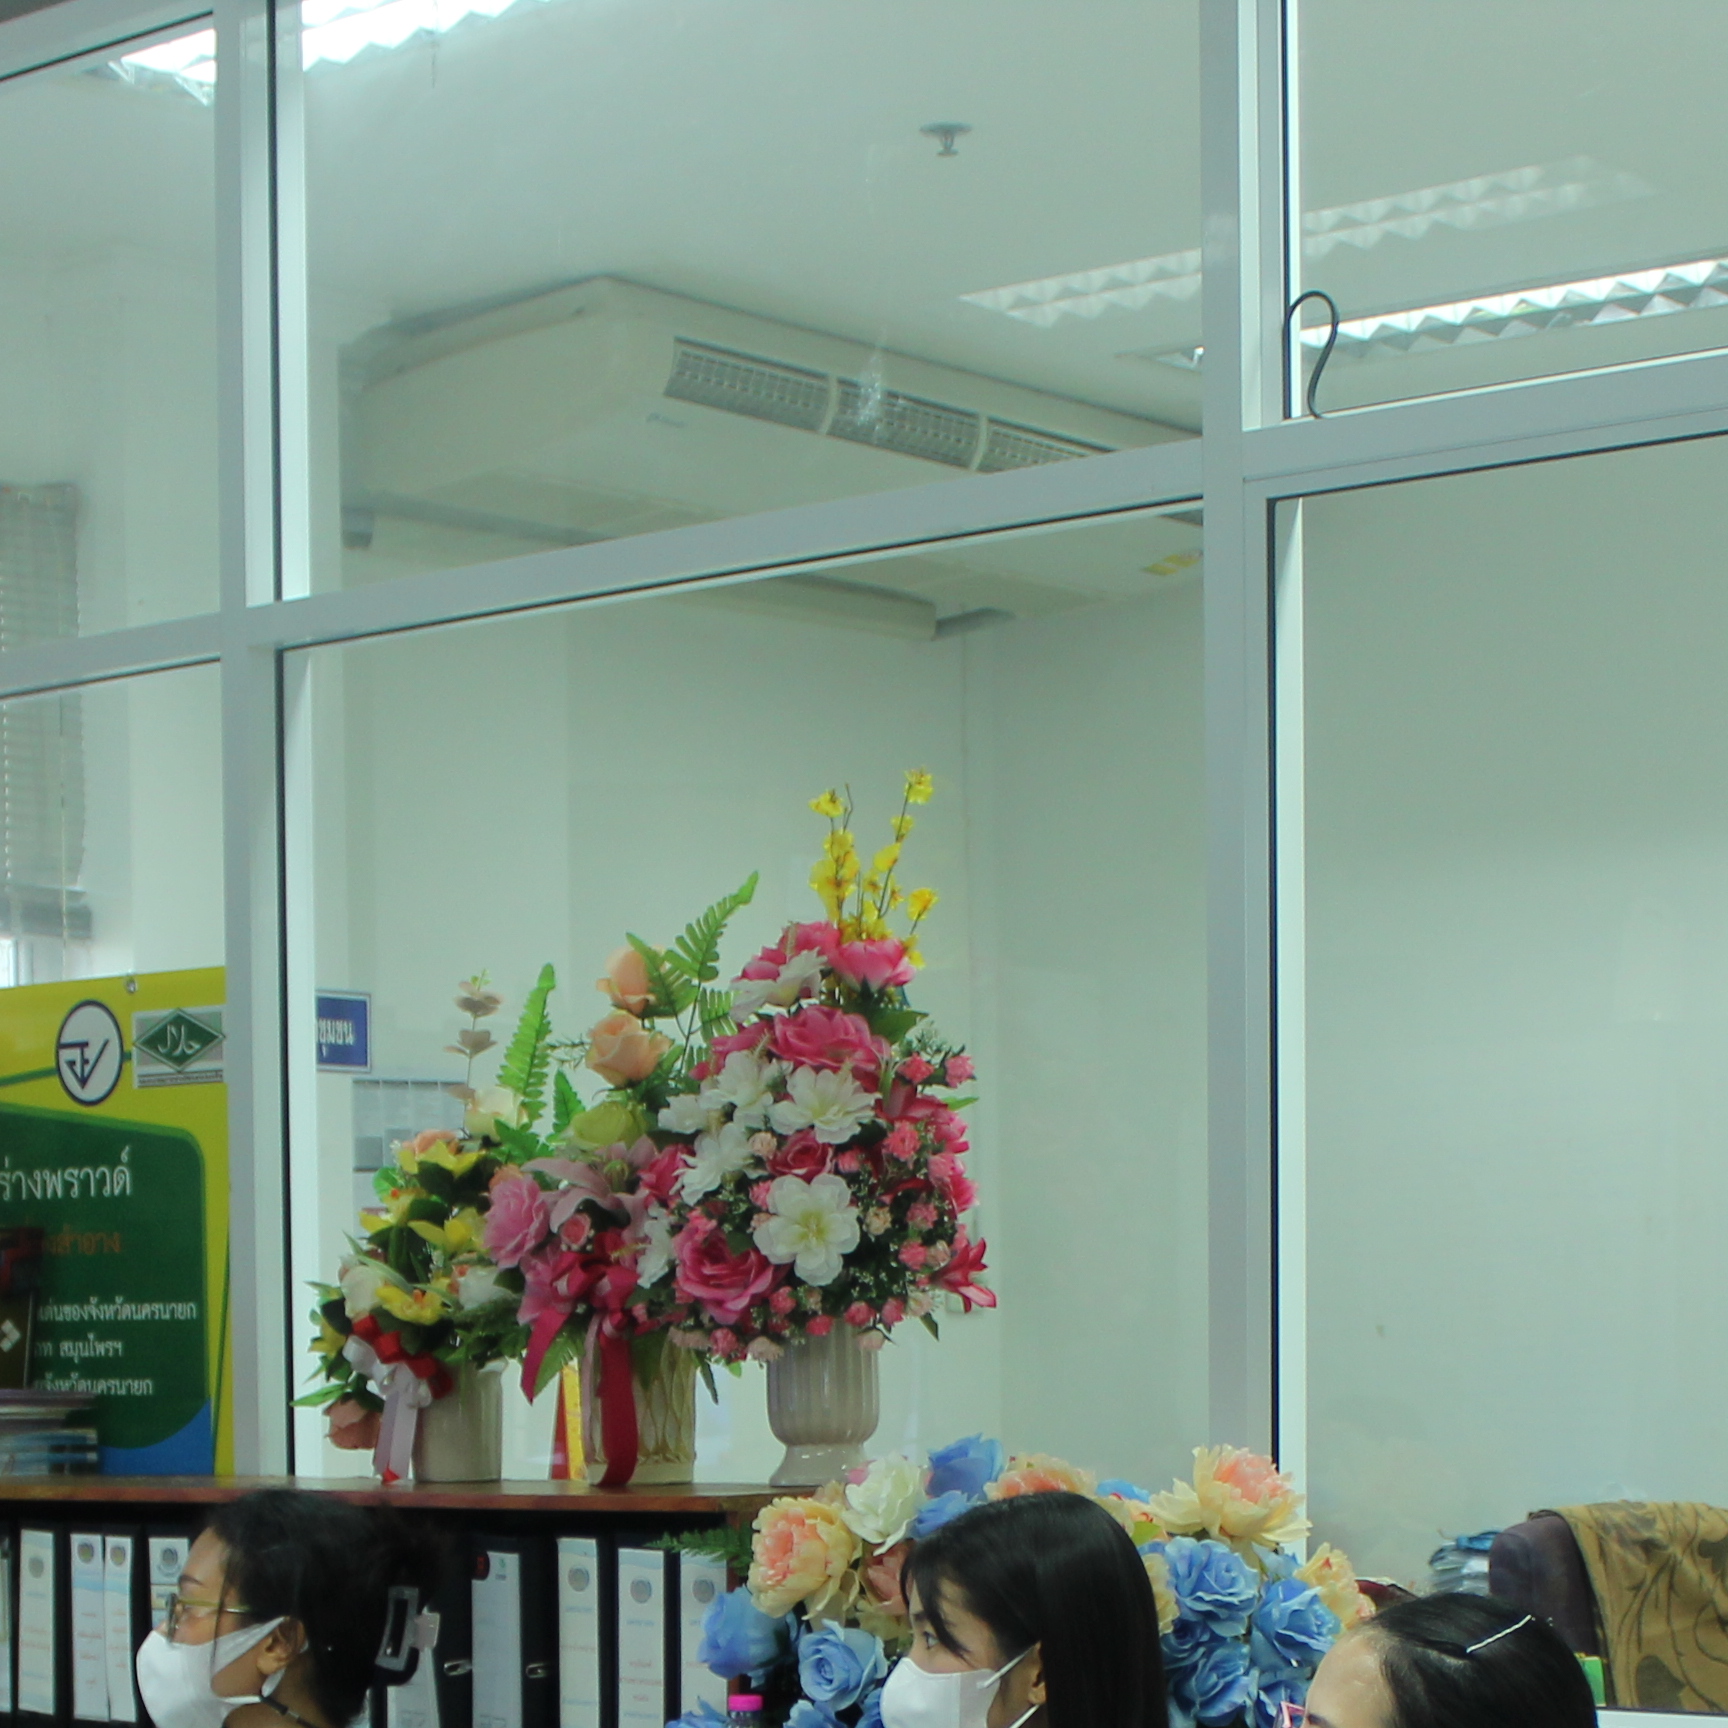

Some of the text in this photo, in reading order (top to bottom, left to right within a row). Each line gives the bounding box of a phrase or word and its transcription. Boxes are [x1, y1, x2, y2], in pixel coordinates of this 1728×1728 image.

[319, 1018, 356, 1058] ชุมชน
[39, 1296, 198, 1322] เด่นของจังหวัดนครนายก
